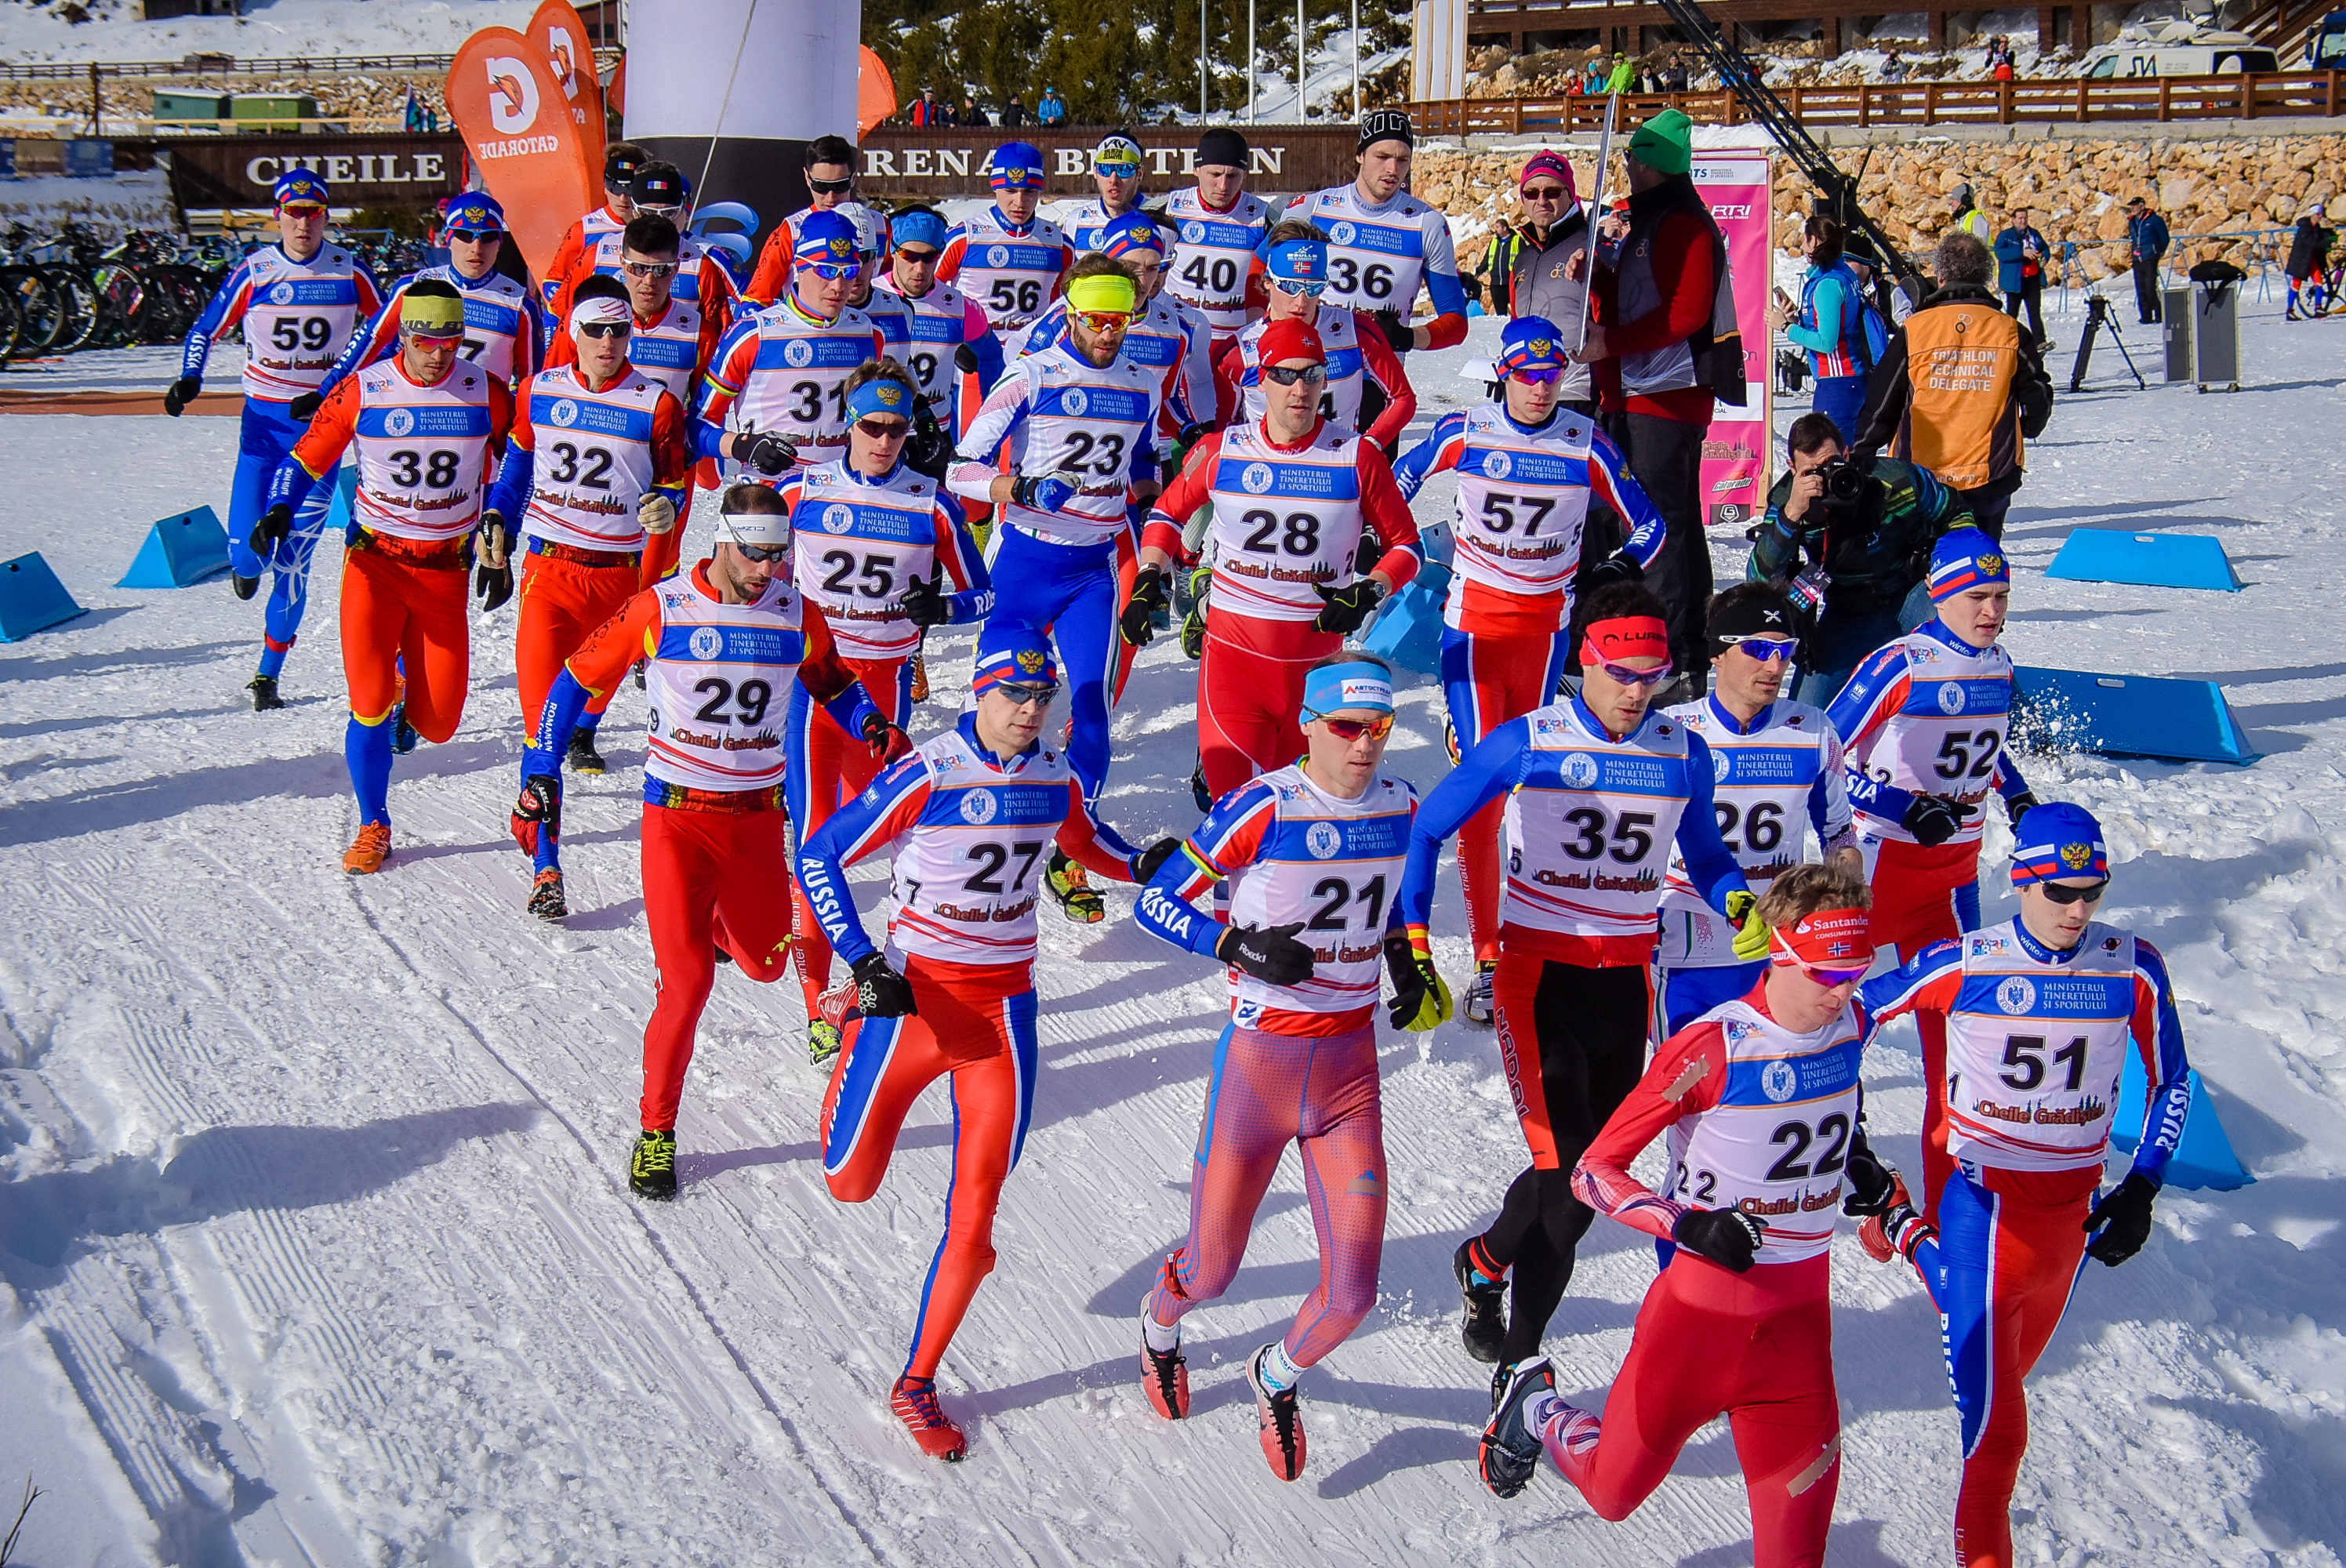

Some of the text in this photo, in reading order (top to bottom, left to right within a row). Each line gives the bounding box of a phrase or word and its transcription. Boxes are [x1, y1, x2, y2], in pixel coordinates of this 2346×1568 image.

[858, 147, 1285, 177] RENA BITLN
[1361, 227, 1402, 238] MINISTERUL
[1367, 240, 1402, 250] SPORTULUI
[1182, 254, 1237, 293] 40
[1328, 256, 1395, 300] 36
[988, 278, 1042, 313] 56
[271, 316, 332, 351] 59
[637, 342, 678, 350] MINISTERUL
[644, 354, 679, 363] SPORTULUI
[1933, 350, 1997, 362] TRIATHLON
[1929, 363, 1996, 377] TECHNICAL
[1929, 377, 1992, 391] DELEGATE
[788, 379, 848, 423] 31
[583, 406, 627, 419] MINISTERUL
[588, 419, 626, 431] SPORTULUI
[1056, 430, 1125, 476] 23
[1517, 457, 1566, 468] MINISTERUL
[388, 448, 461, 489] 38
[550, 441, 614, 492] 32
[1280, 469, 1331, 478] MINISTERUL
[1524, 471, 1567, 480] SPORTULUI
[1279, 476, 1331, 485] TINERETULUI
[1288, 484, 1332, 492] SPORTULUI
[859, 511, 910, 522] MINISTERUL
[1480, 491, 1557, 537] 57
[867, 525, 910, 536] SPORTULUI
[1240, 507, 1320, 557] 28
[821, 549, 896, 599] 25
[1226, 559, 1269, 579] Cheile
[729, 632, 781, 642] MINISTERUL
[729, 639, 781, 649] TINERETULUI
[739, 648, 782, 657] SPORTULUI
[1854, 684, 1866, 695] NW
[692, 676, 772, 727] 29
[675, 728, 720, 749] Cheile
[1933, 728, 2000, 781] 52
[1605, 760, 1664, 771] MINISTERUL
[1605, 768, 1665, 779] TINERETULUI
[1615, 778, 1665, 788] SPORTULUI
[1347, 823, 1392, 833] MINISTERUL
[1560, 806, 1657, 866] 35
[1713, 800, 1785, 853] 26
[1357, 840, 1396, 850] SPORTULUI
[961, 840, 1044, 895] 27
[1538, 869, 1591, 890] Cheile
[801, 858, 849, 944] RUSSIA
[1305, 873, 1386, 931] 21
[940, 902, 989, 922] Cheile
[1465, 898, 1476, 933] winter
[1813, 914, 1868, 931] Santander
[1815, 930, 1851, 939] CONSUMER
[1239, 942, 1266, 963] Roeckl
[2021, 935, 2044, 957] winter
[795, 946, 808, 984] winter
[1417, 964, 1435, 986] LEKI
[1999, 975, 2033, 992] GUVERNUL
[2043, 982, 2106, 993] MINISTERUL
[2043, 991, 2107, 1000] TINERETULUI
[1999, 998, 2034, 1014] ROMÂNIEI
[2054, 1000, 2107, 1010] SPORTULUI
[1801, 1053, 1843, 1071] MINISTERUL
[1998, 1033, 2089, 1092] 51
[1813, 1070, 1849, 1089] SPORTULUI
[1977, 1100, 2105, 1127] Cheile Grădiștei
[1763, 1111, 1850, 1182] 22
[1676, 1161, 1719, 1206] 22
[1739, 1196, 1798, 1215] Cheile
[1731, 1211, 1761, 1247] SWIX
